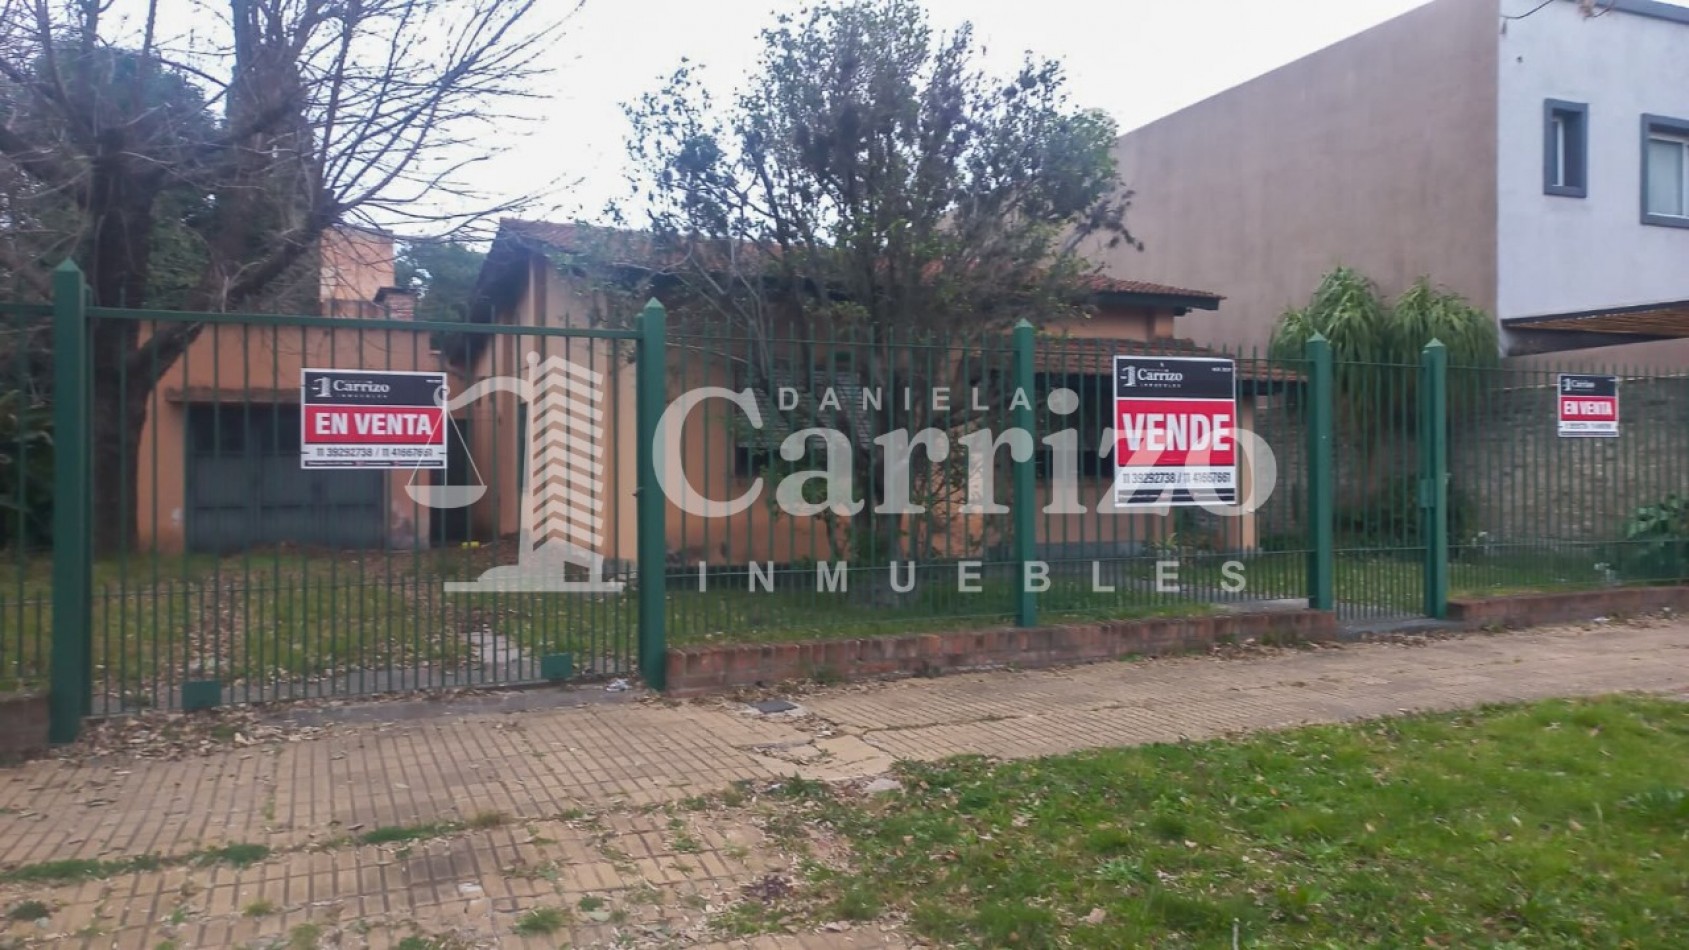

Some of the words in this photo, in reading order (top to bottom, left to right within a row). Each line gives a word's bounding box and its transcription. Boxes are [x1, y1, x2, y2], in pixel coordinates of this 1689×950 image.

[1137, 368, 1183, 382] Carrizo
[333, 379, 390, 393] Carrizo
[315, 412, 348, 435] EN
[354, 413, 434, 436] VENTA
[1122, 412, 1231, 452] VENDE
